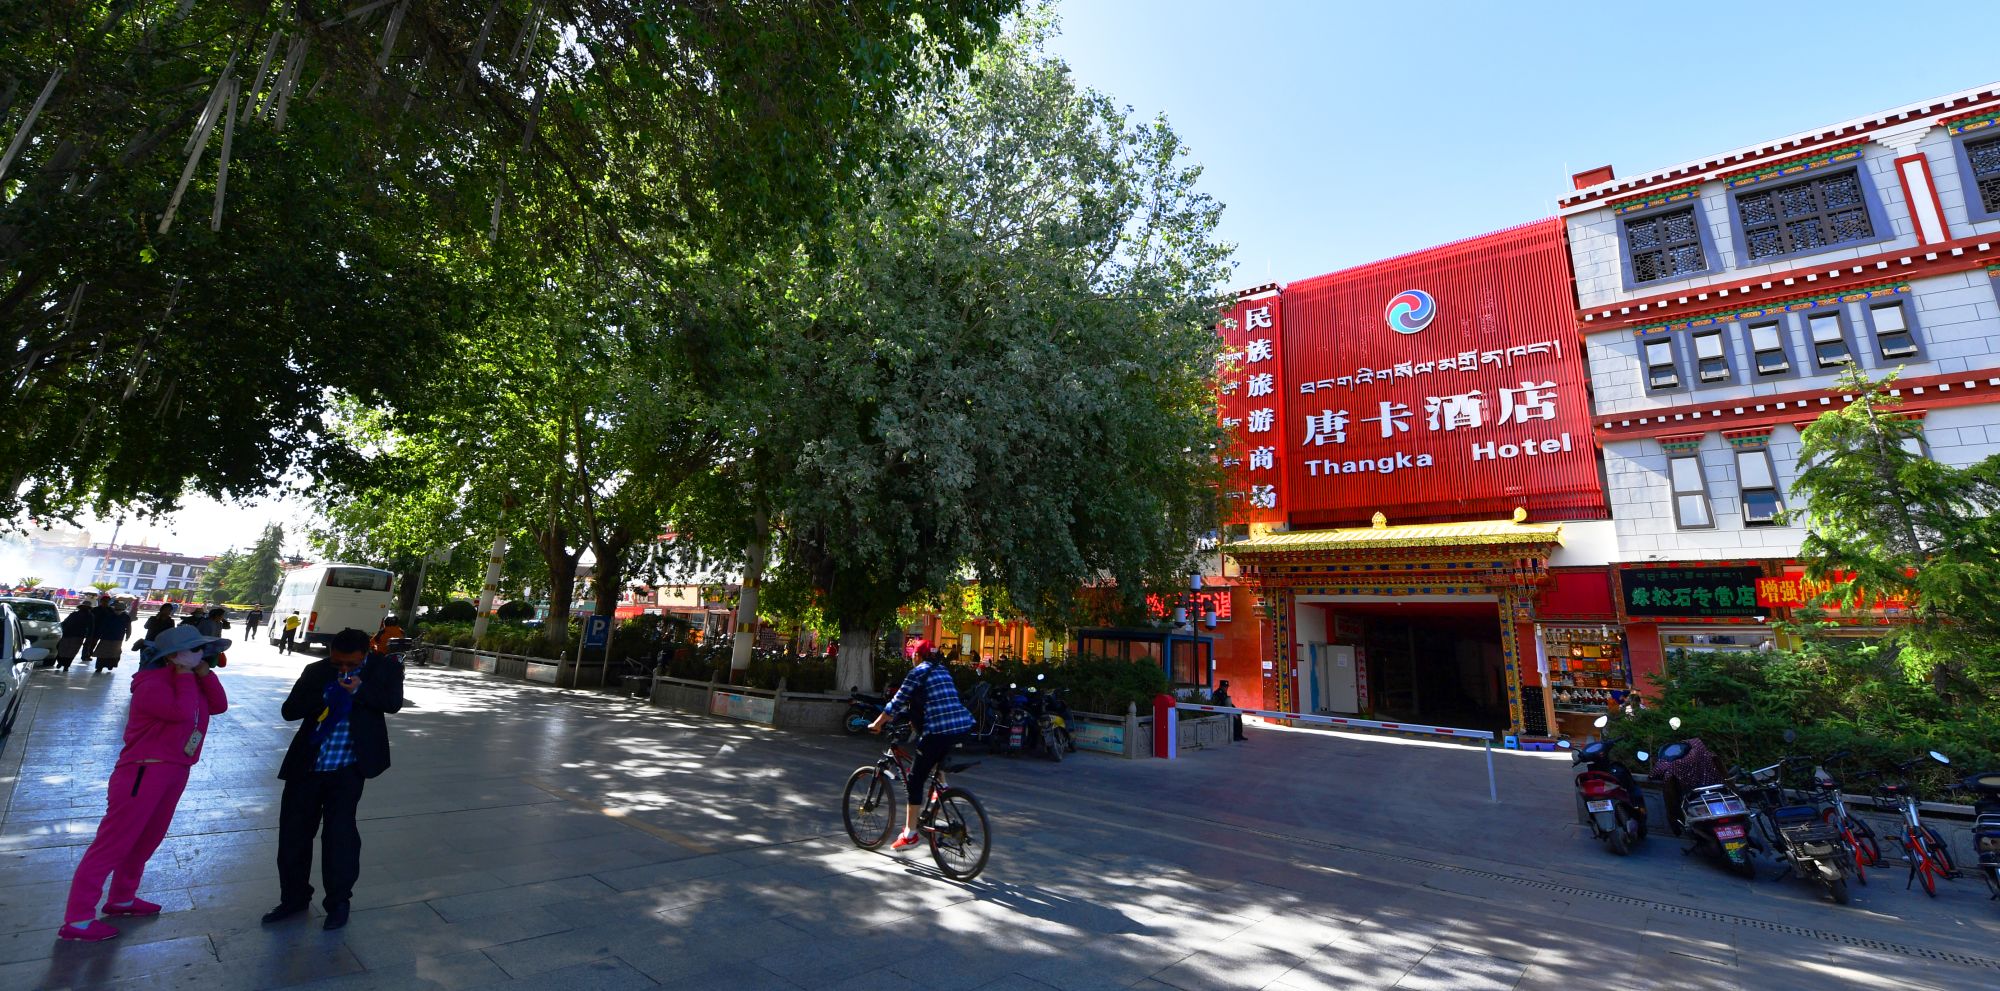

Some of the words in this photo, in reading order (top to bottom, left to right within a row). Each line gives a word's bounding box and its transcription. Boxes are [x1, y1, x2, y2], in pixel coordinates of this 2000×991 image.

[1245, 306, 1277, 509] 民族旅游商场
[1302, 380, 1559, 446] 唐卡酒店
[1304, 451, 1434, 477] Thangka
[1472, 432, 1573, 462] Hotel
[592, 620, 606, 636] P
